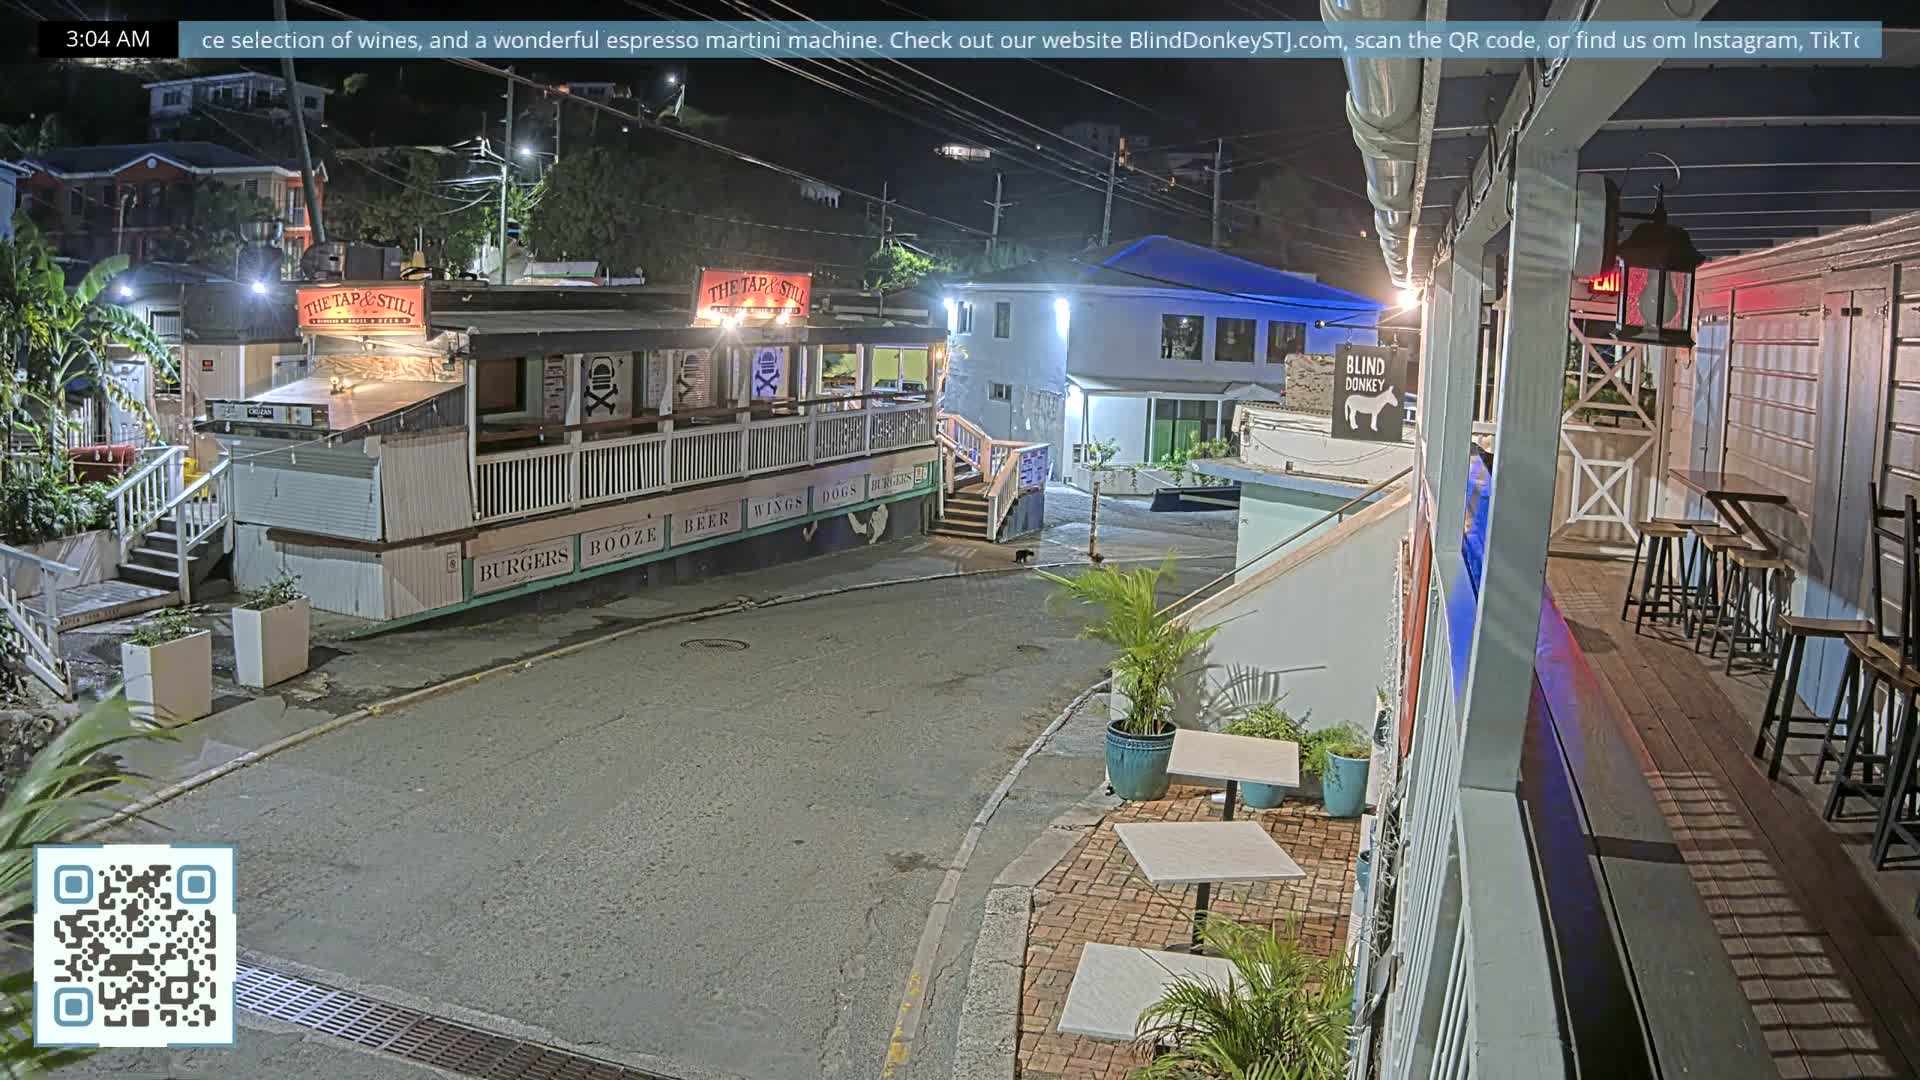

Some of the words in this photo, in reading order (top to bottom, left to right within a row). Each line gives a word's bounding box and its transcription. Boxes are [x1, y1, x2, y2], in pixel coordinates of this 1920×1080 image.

[708, 280, 738, 303] THE
[741, 276, 767, 293] TAP
[780, 280, 804, 306] STILL
[304, 296, 332, 317] THE
[332, 292, 360, 307] TAP
[359, 291, 376, 307] &
[377, 293, 416, 317] STILL
[1346, 355, 1385, 376] BLIND
[1345, 376, 1385, 392] DONKEY
[871, 472, 912, 491] BURGERS
[823, 486, 857, 503] DOGS
[754, 499, 802, 518] WINGS
[684, 511, 729, 534] BEER
[591, 527, 656, 556] BOOZE
[480, 548, 569, 582] BURGERS
